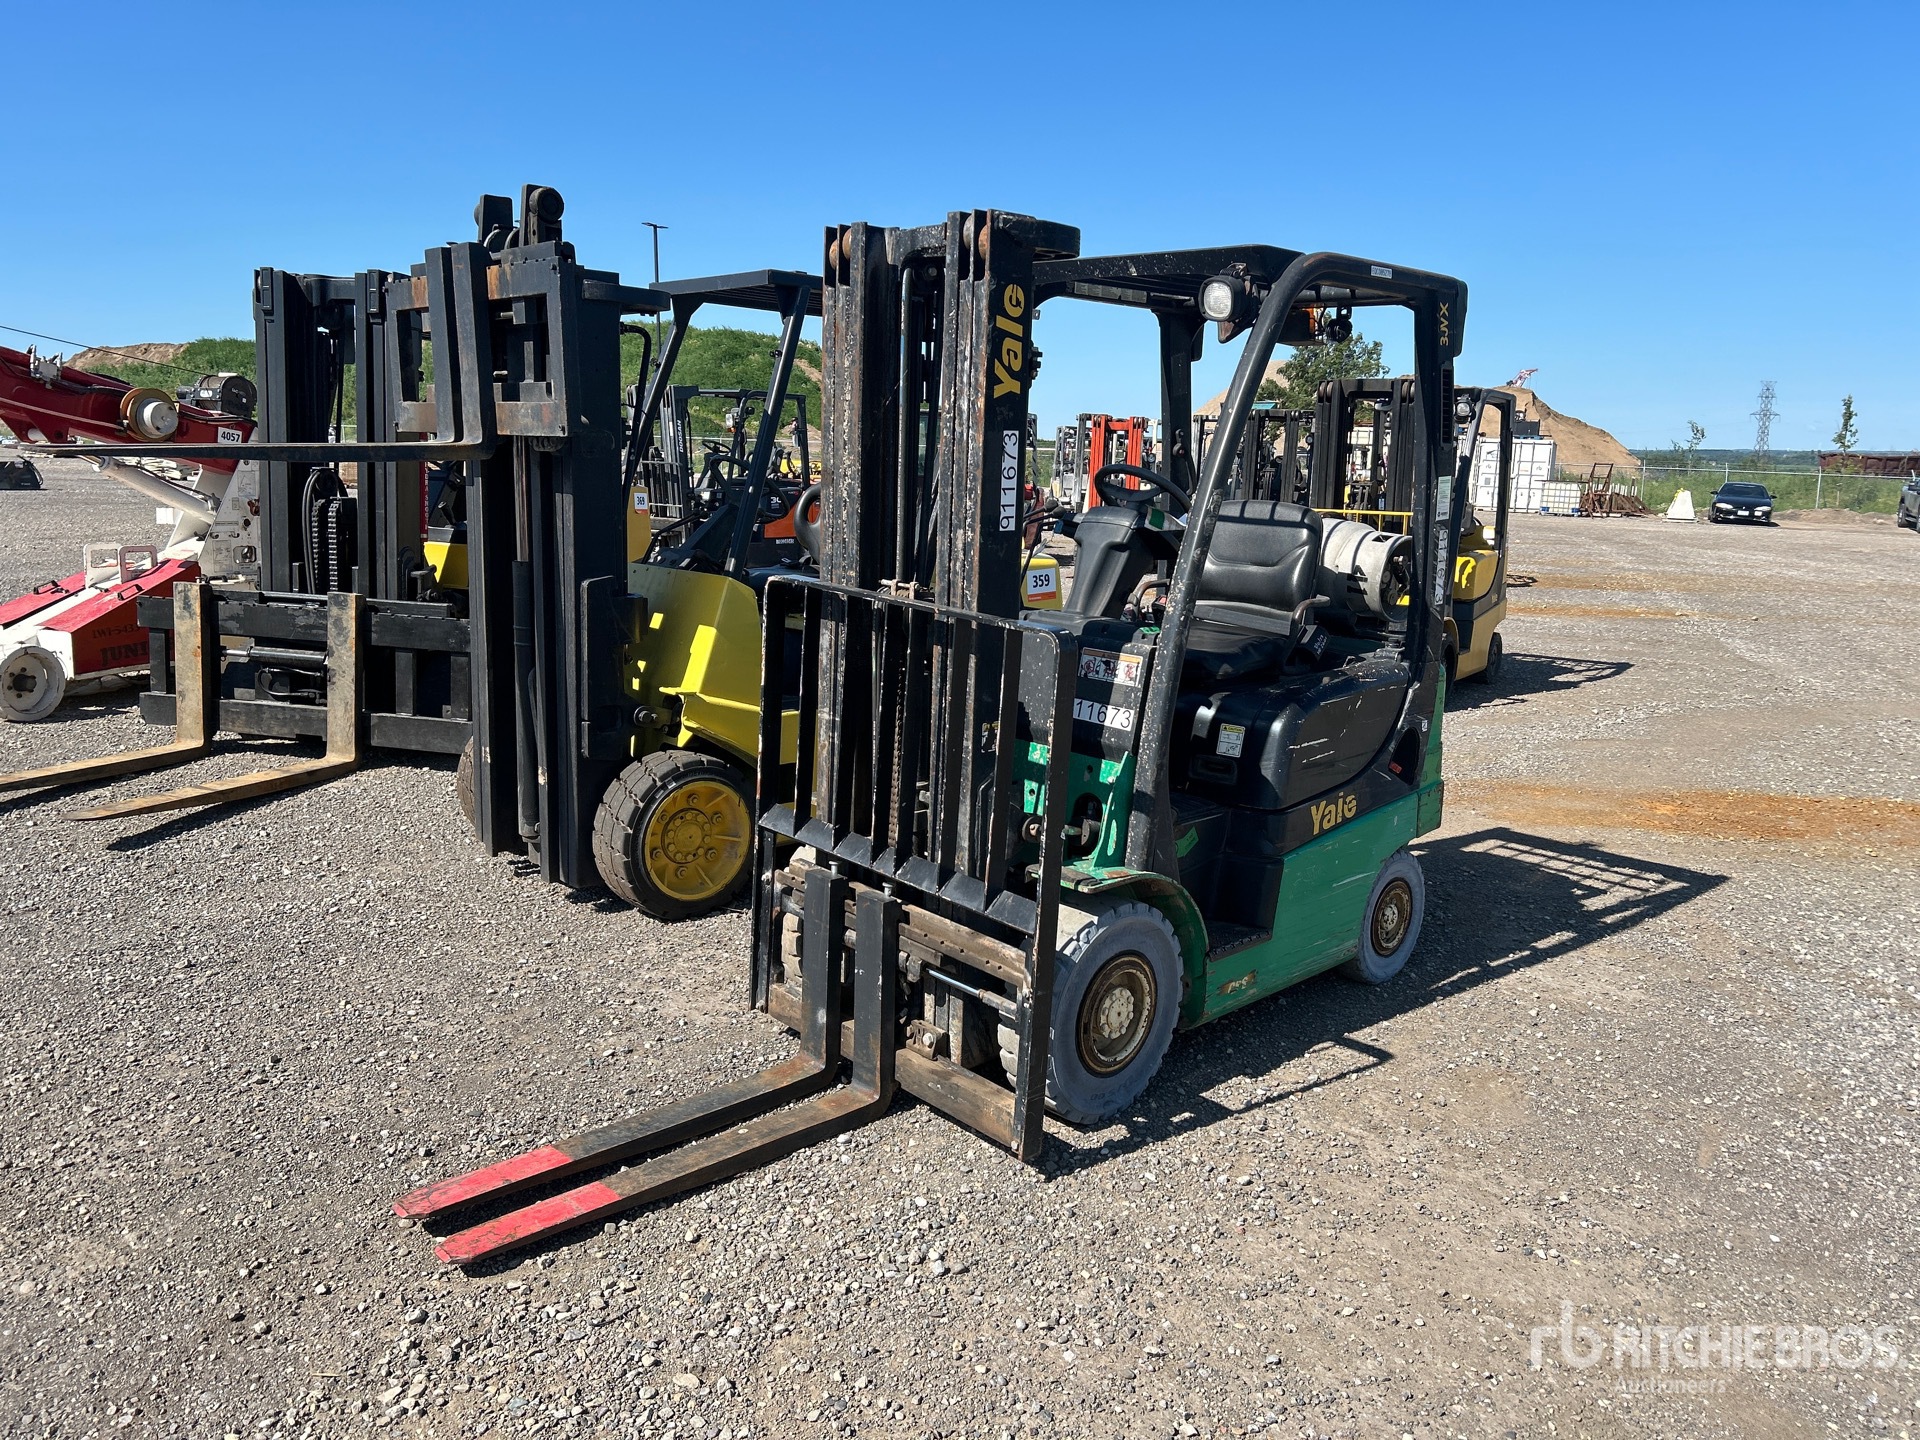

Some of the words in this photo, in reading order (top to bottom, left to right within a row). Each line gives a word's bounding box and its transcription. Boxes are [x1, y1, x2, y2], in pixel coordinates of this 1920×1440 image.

[994, 283, 1025, 399] Yale
[221, 431, 241, 442] 4057
[1000, 433, 1018, 529] 911673
[636, 496, 646, 506] 369
[1032, 573, 1050, 588] 359
[1076, 700, 1132, 729] 11673
[1310, 791, 1357, 836] Yale
